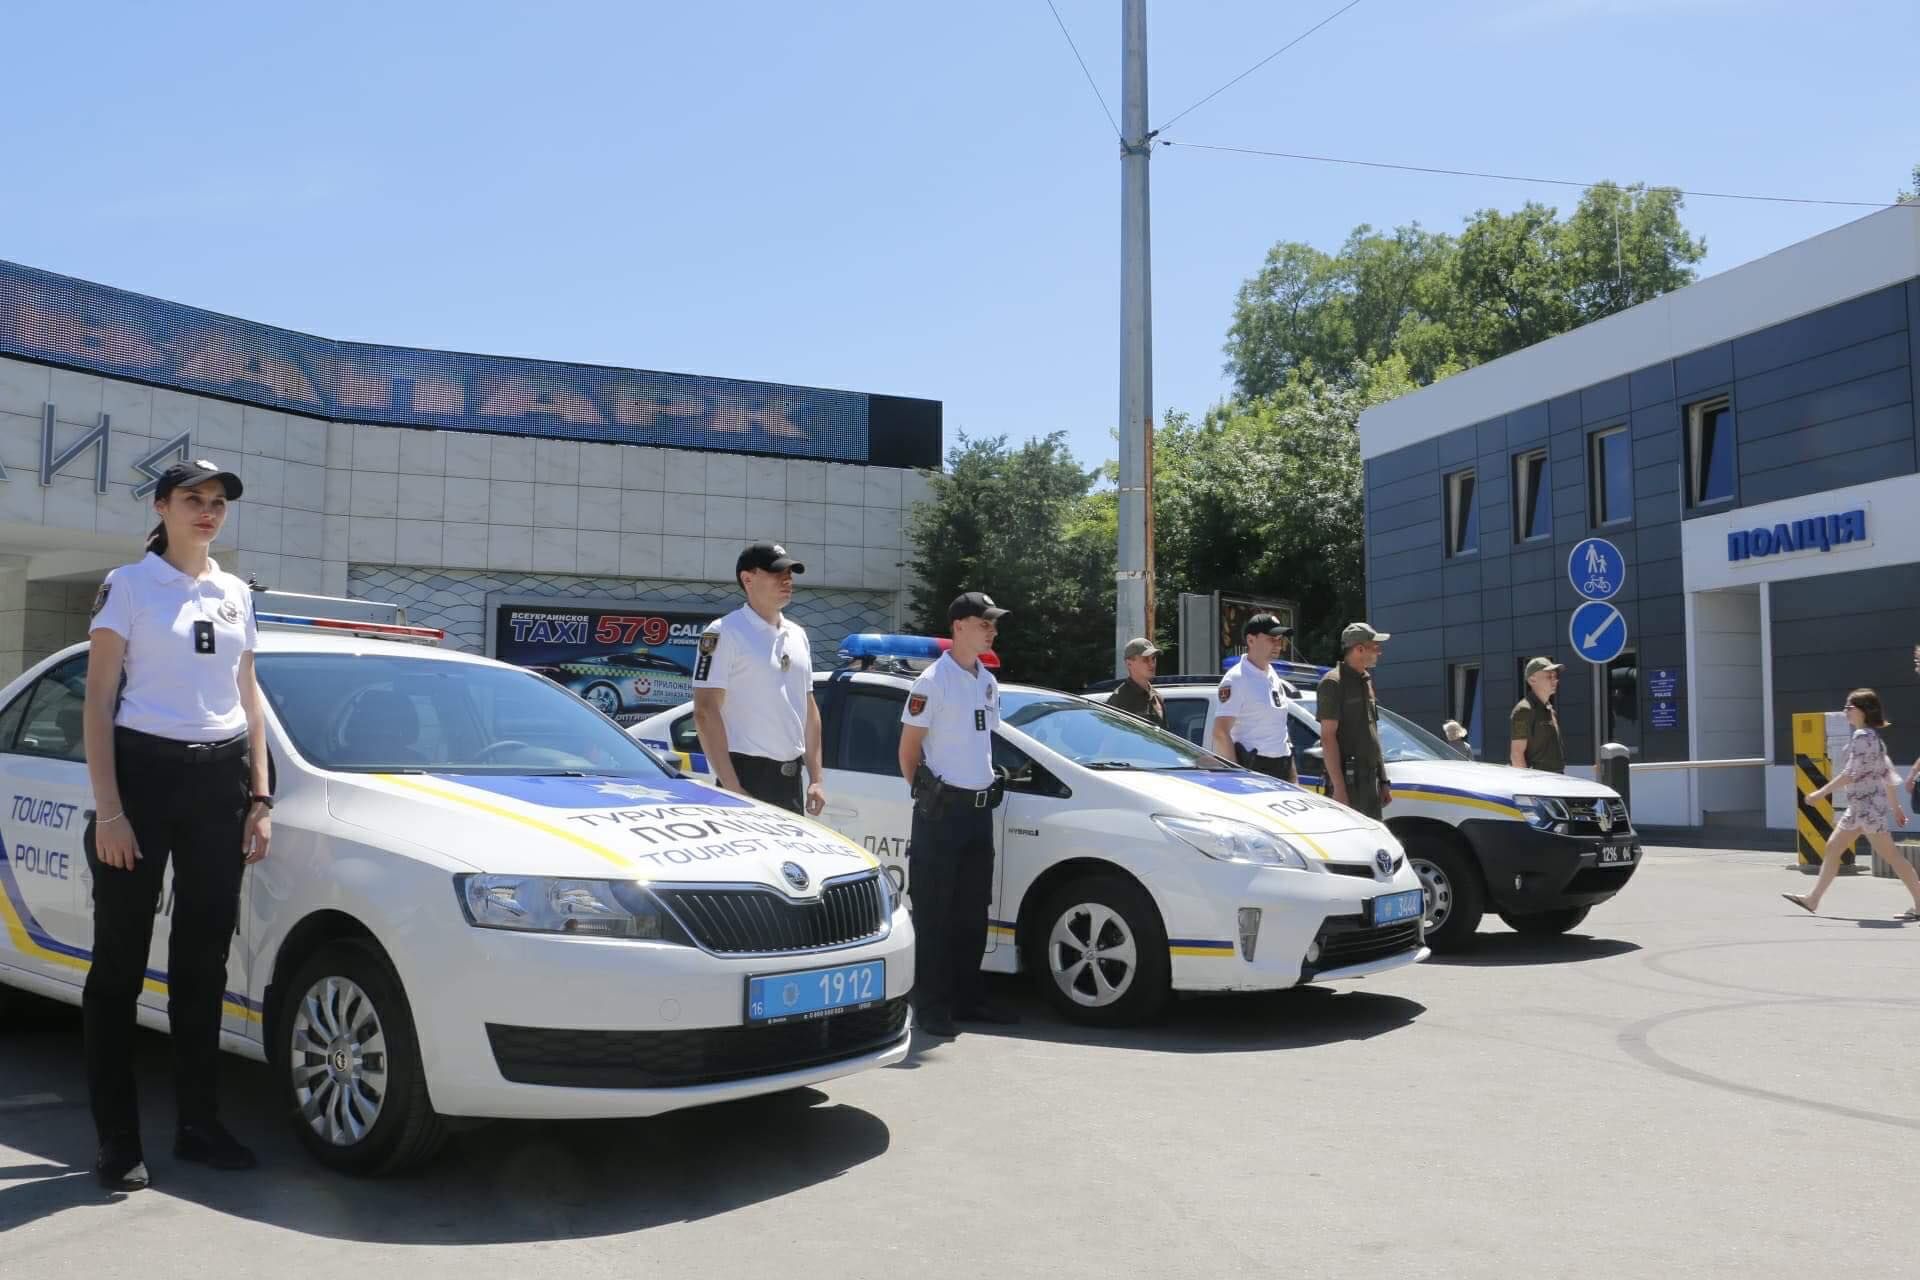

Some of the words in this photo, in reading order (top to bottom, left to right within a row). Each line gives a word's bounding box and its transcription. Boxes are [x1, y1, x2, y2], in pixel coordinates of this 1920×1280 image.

[0, 402, 191, 499] ИЯ
[1727, 510, 1866, 562] ПОЛІЦІЯ
[510, 619, 589, 644] TAXI
[595, 615, 669, 646] 579
[669, 623, 705, 637] CAL
[511, 611, 590, 622] ВСЕУКРАИНСКОЕ
[653, 679, 692, 691] ПРИЛОЖЕН
[11, 794, 78, 831] TOURIST
[629, 819, 818, 844] ПОЛІЦІЯ
[15, 844, 69, 880] POLICE
[639, 839, 769, 868] TOURIST
[773, 839, 862, 859] POLICE
[751, 1001, 763, 1017] 16
[819, 967, 872, 1005] 1912
